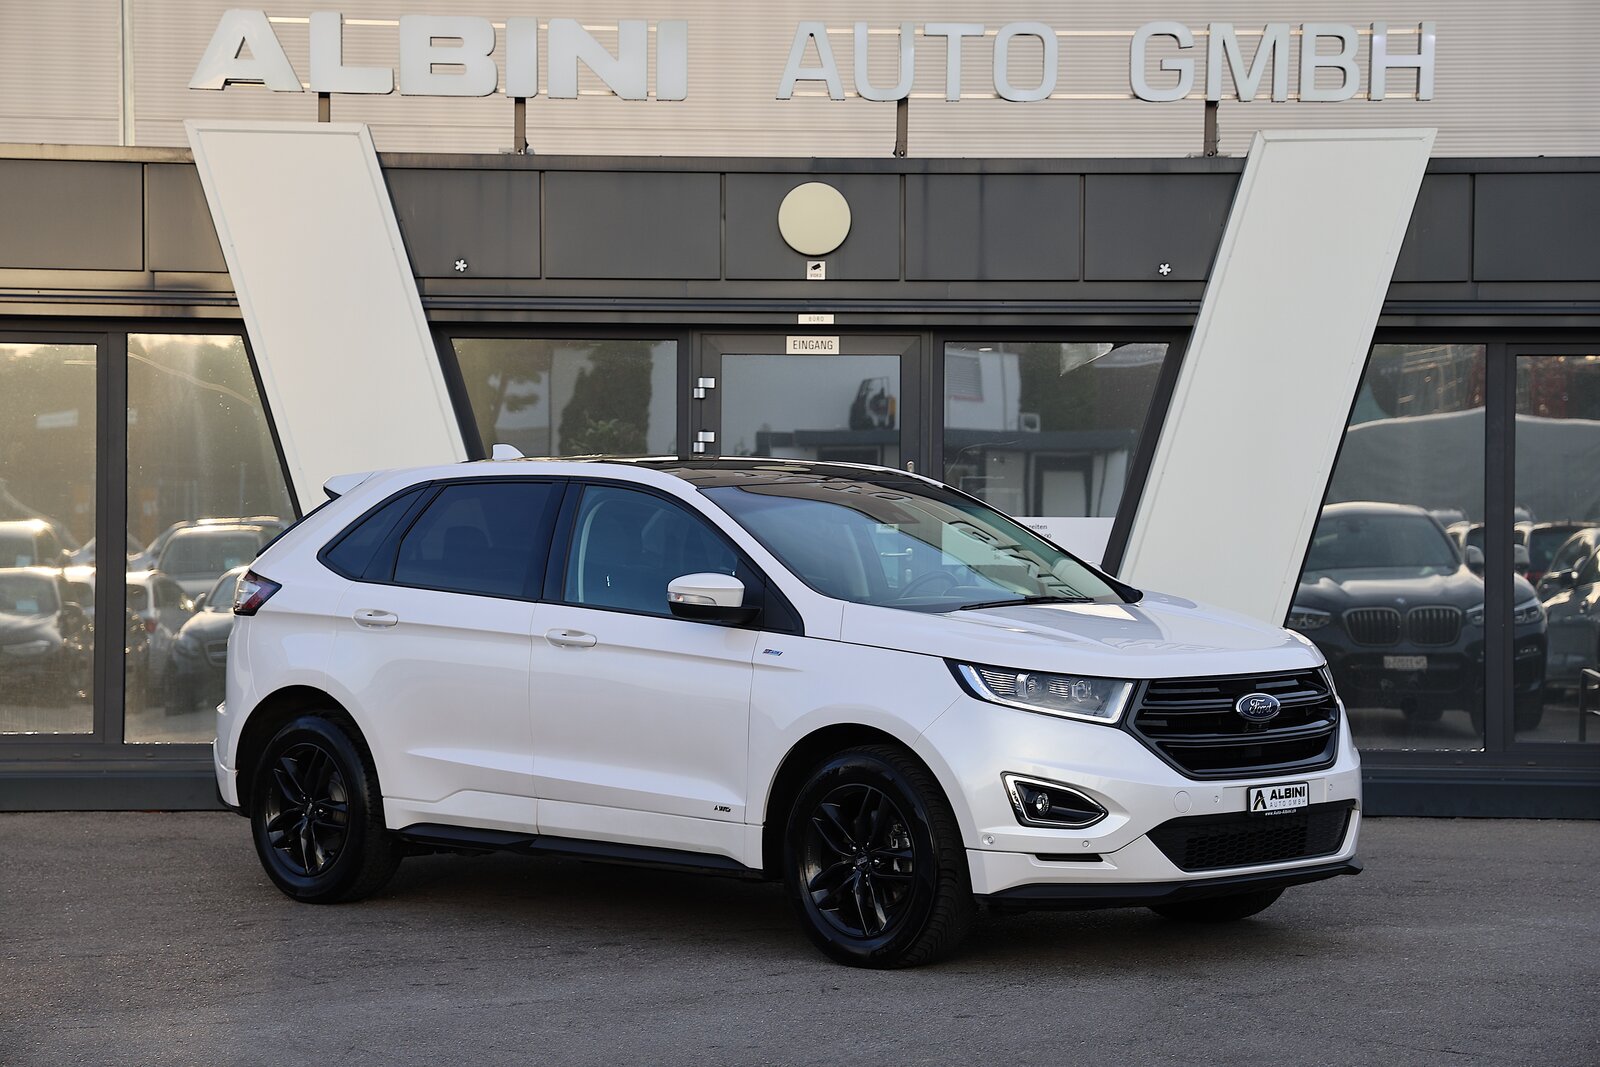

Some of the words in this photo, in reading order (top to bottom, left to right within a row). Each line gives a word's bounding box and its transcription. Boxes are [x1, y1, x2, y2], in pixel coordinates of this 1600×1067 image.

[189, 9, 688, 101] ALBINI
[777, 21, 1059, 101] AUTO
[1130, 21, 1438, 103] GMBH
[793, 340, 833, 350] EINGANG
[1248, 698, 1272, 714] Ford
[1270, 787, 1305, 800] ALBINI
